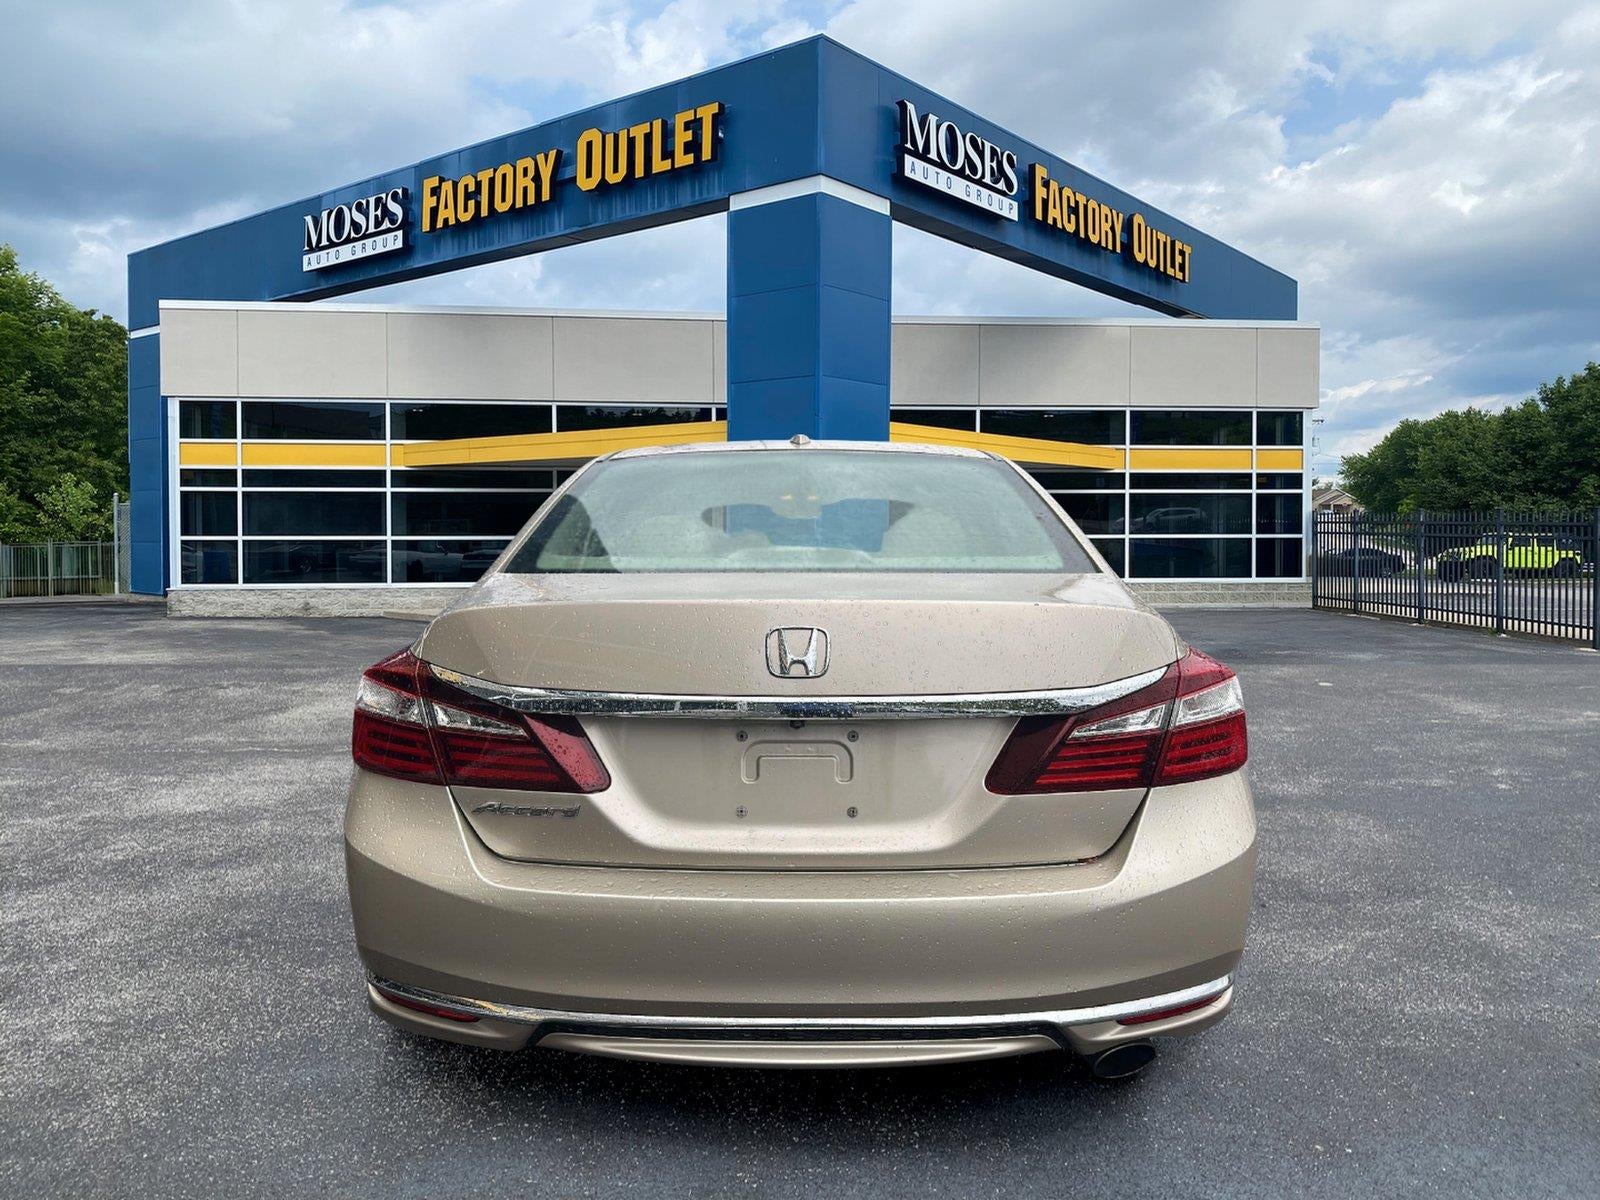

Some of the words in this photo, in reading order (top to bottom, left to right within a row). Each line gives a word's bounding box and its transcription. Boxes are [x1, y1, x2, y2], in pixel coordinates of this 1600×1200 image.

[422, 149, 560, 233] FACTORY
[576, 101, 720, 192] OUTLET
[904, 99, 1018, 196] MOSES
[303, 188, 403, 251] MOSES
[909, 161, 953, 190] AUTO
[965, 184, 1015, 215] GROUP
[1033, 162, 1124, 254] FACTORY
[1131, 212, 1192, 283] OUTLET
[306, 249, 341, 268] AUTO
[350, 236, 400, 256] GROUP
